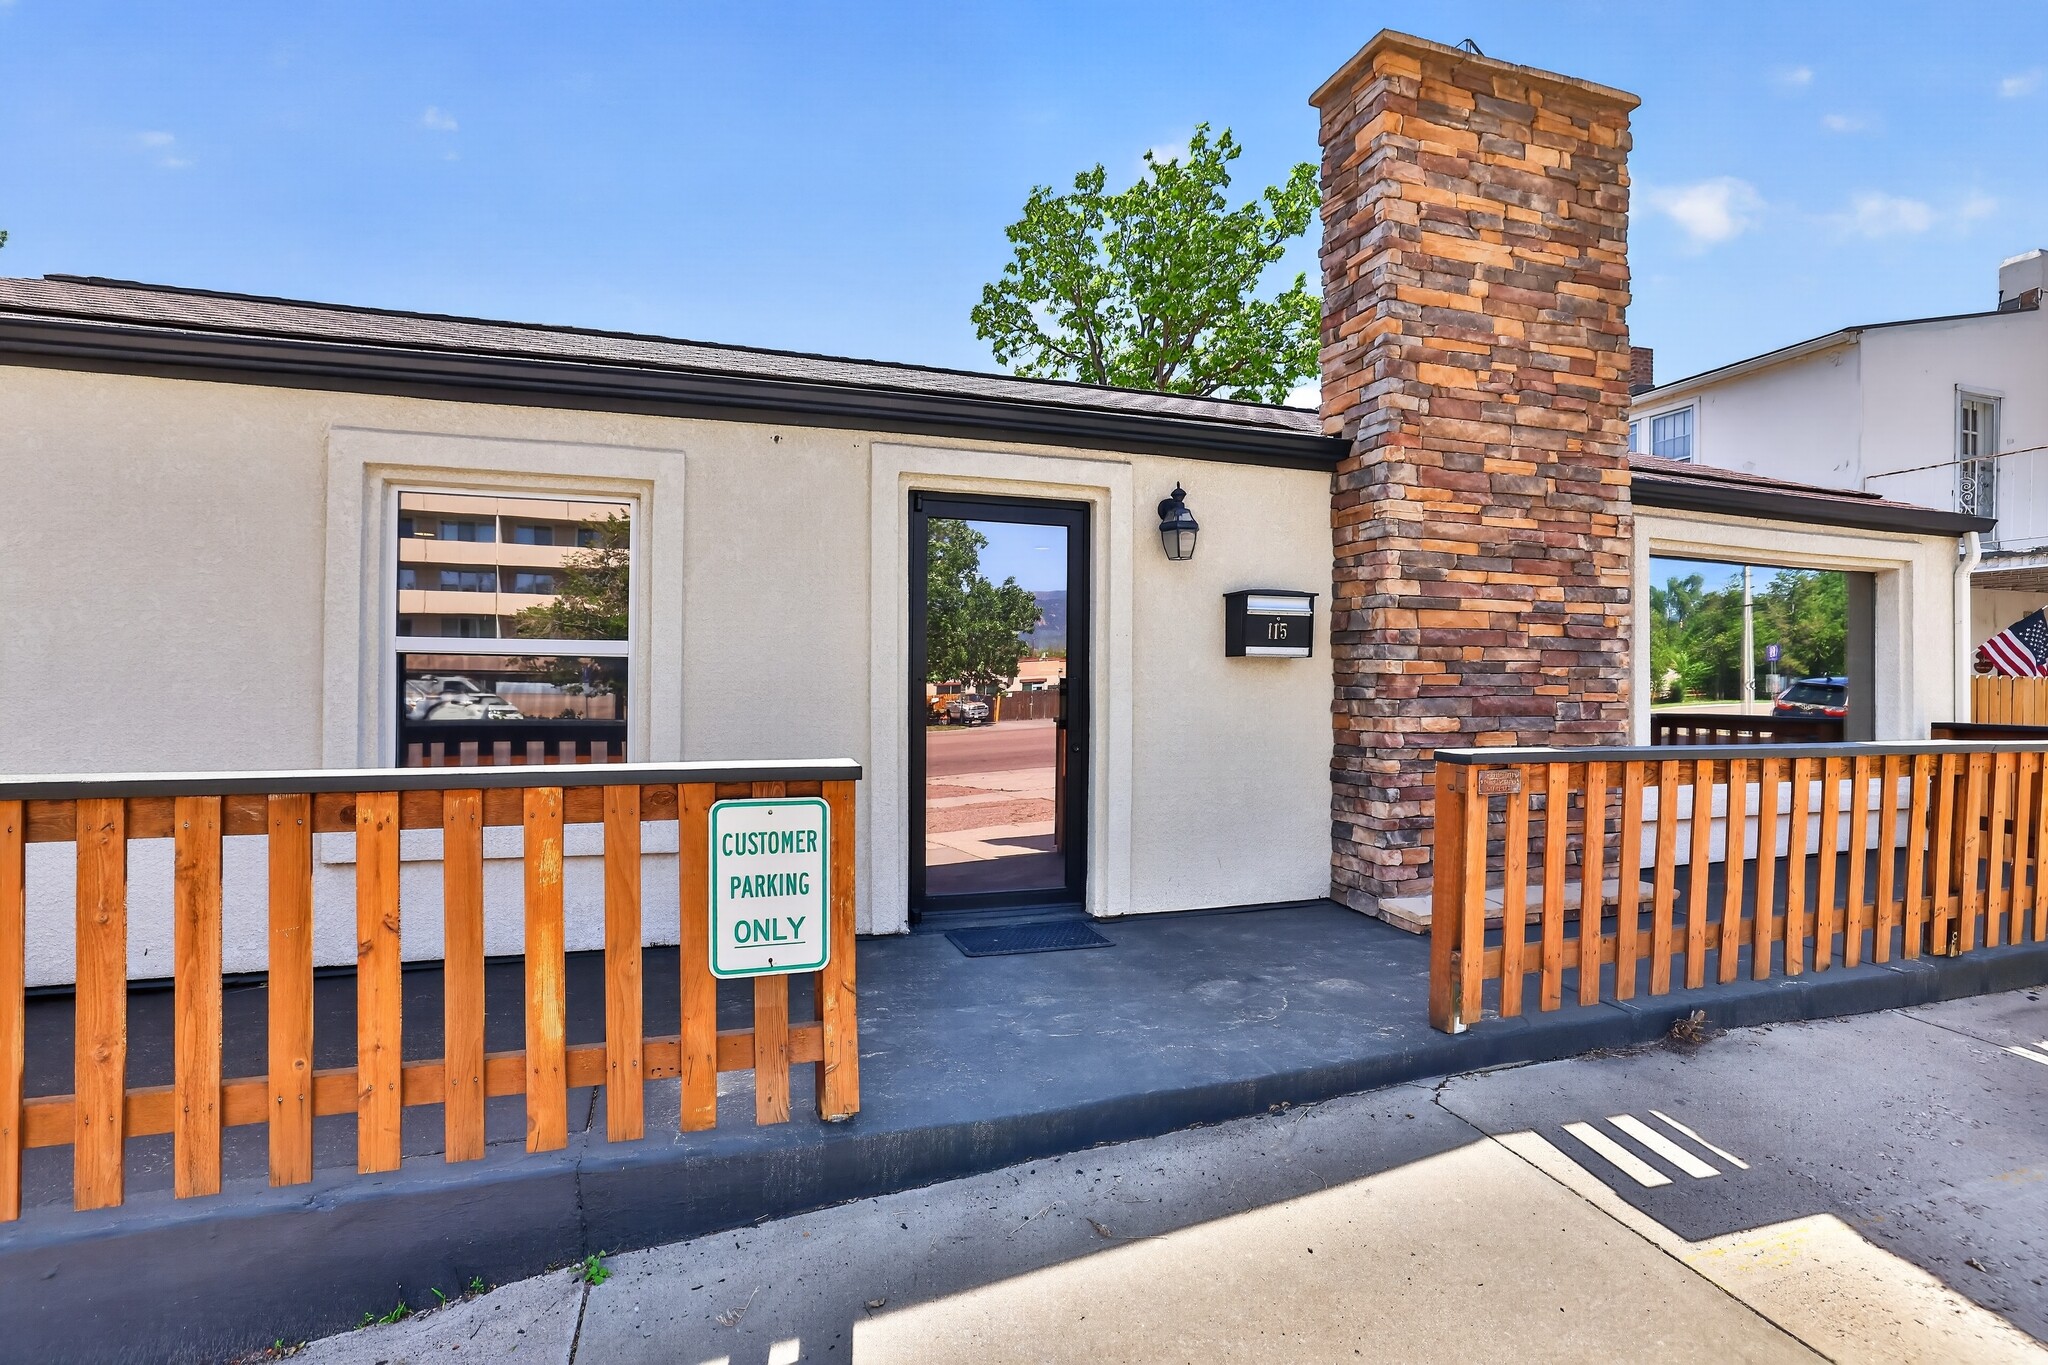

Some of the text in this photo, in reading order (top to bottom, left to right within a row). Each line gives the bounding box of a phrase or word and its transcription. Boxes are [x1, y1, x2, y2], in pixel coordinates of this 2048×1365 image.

[1268, 622, 1288, 640] 115
[722, 829, 818, 856] CUSTOMER
[730, 872, 810, 899] PARKING
[734, 916, 806, 943] ONLY
